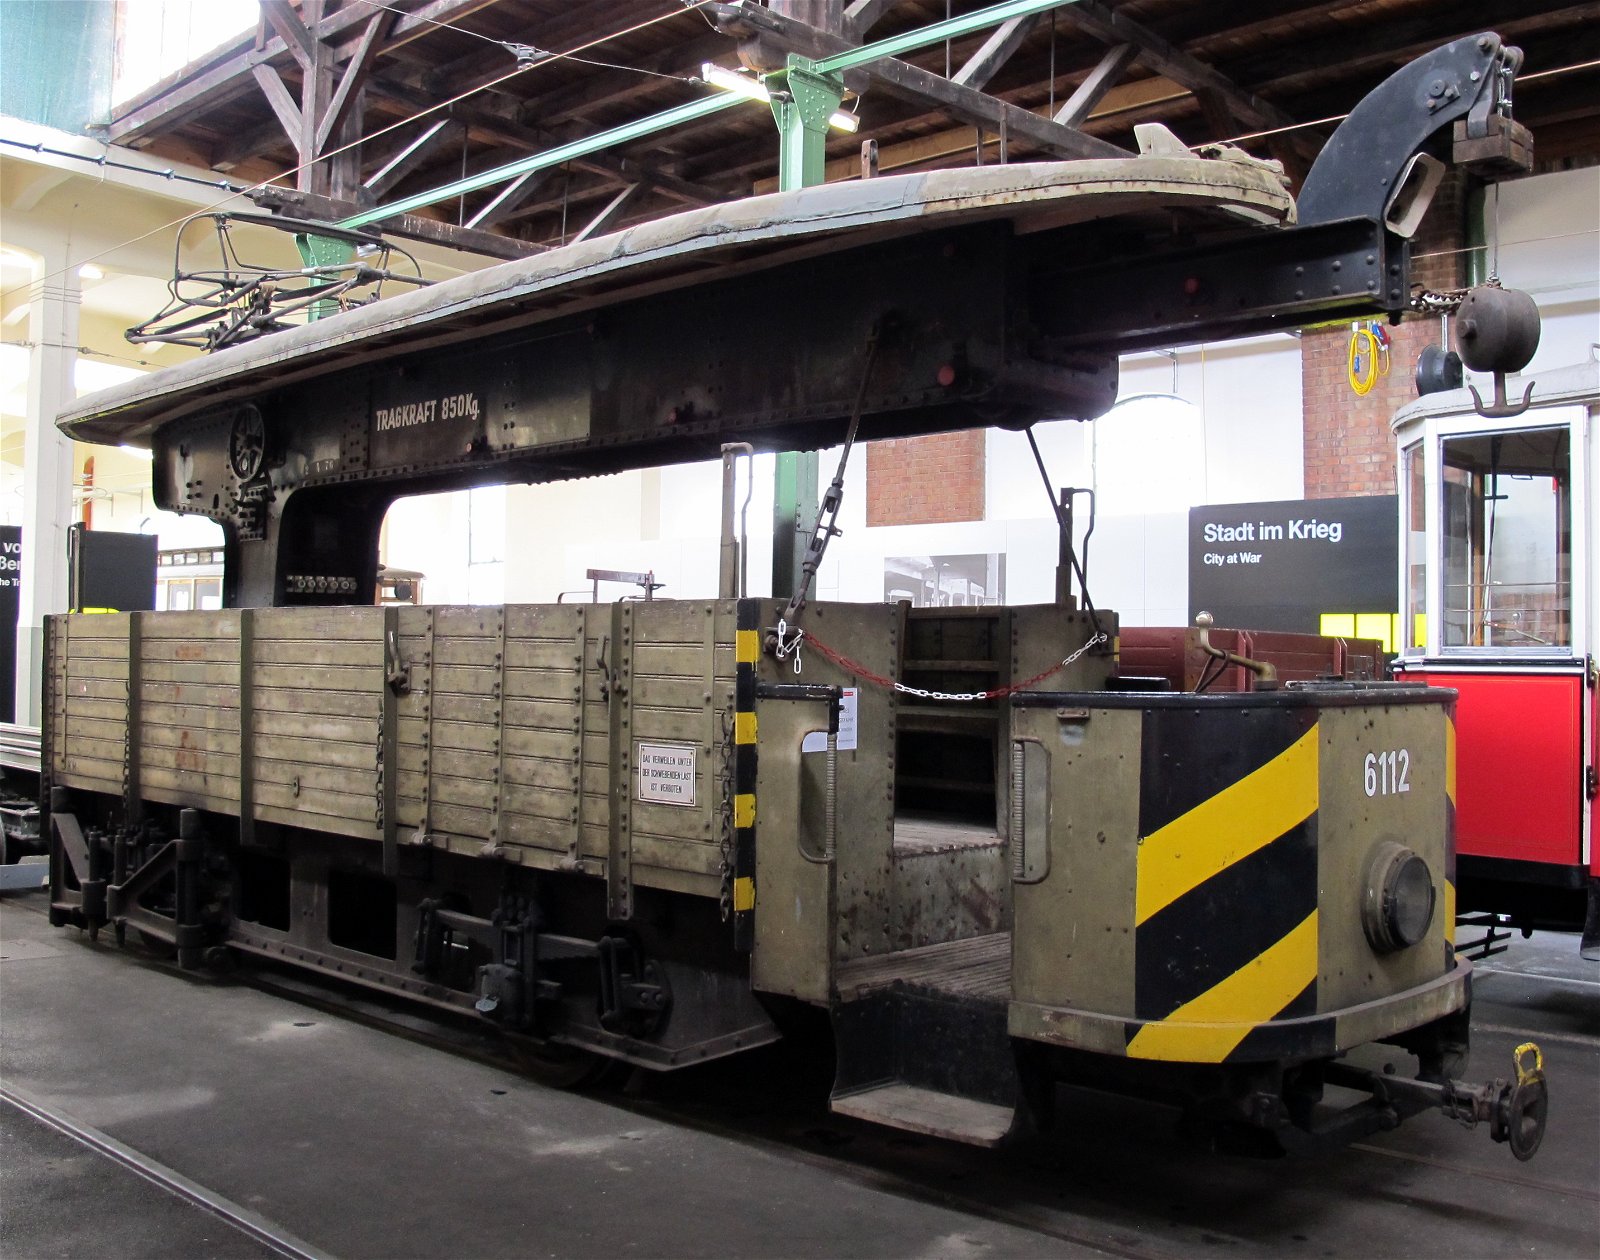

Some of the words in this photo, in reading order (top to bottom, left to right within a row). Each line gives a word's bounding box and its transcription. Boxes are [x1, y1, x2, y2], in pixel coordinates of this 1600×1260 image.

[376, 400, 437, 432] TRAGKRAFT
[1203, 522, 1255, 543] Stadt
[1259, 521, 1283, 540] im
[1288, 519, 1342, 543] Krieg
[1203, 553, 1225, 566] City
[1226, 553, 1238, 564] at
[1239, 552, 1262, 564] War
[653, 756, 675, 765] VERWEILEN
[678, 758, 691, 766] UNTER
[1364, 748, 1410, 797] 6112
[661, 784, 682, 793] VERBOTEN
